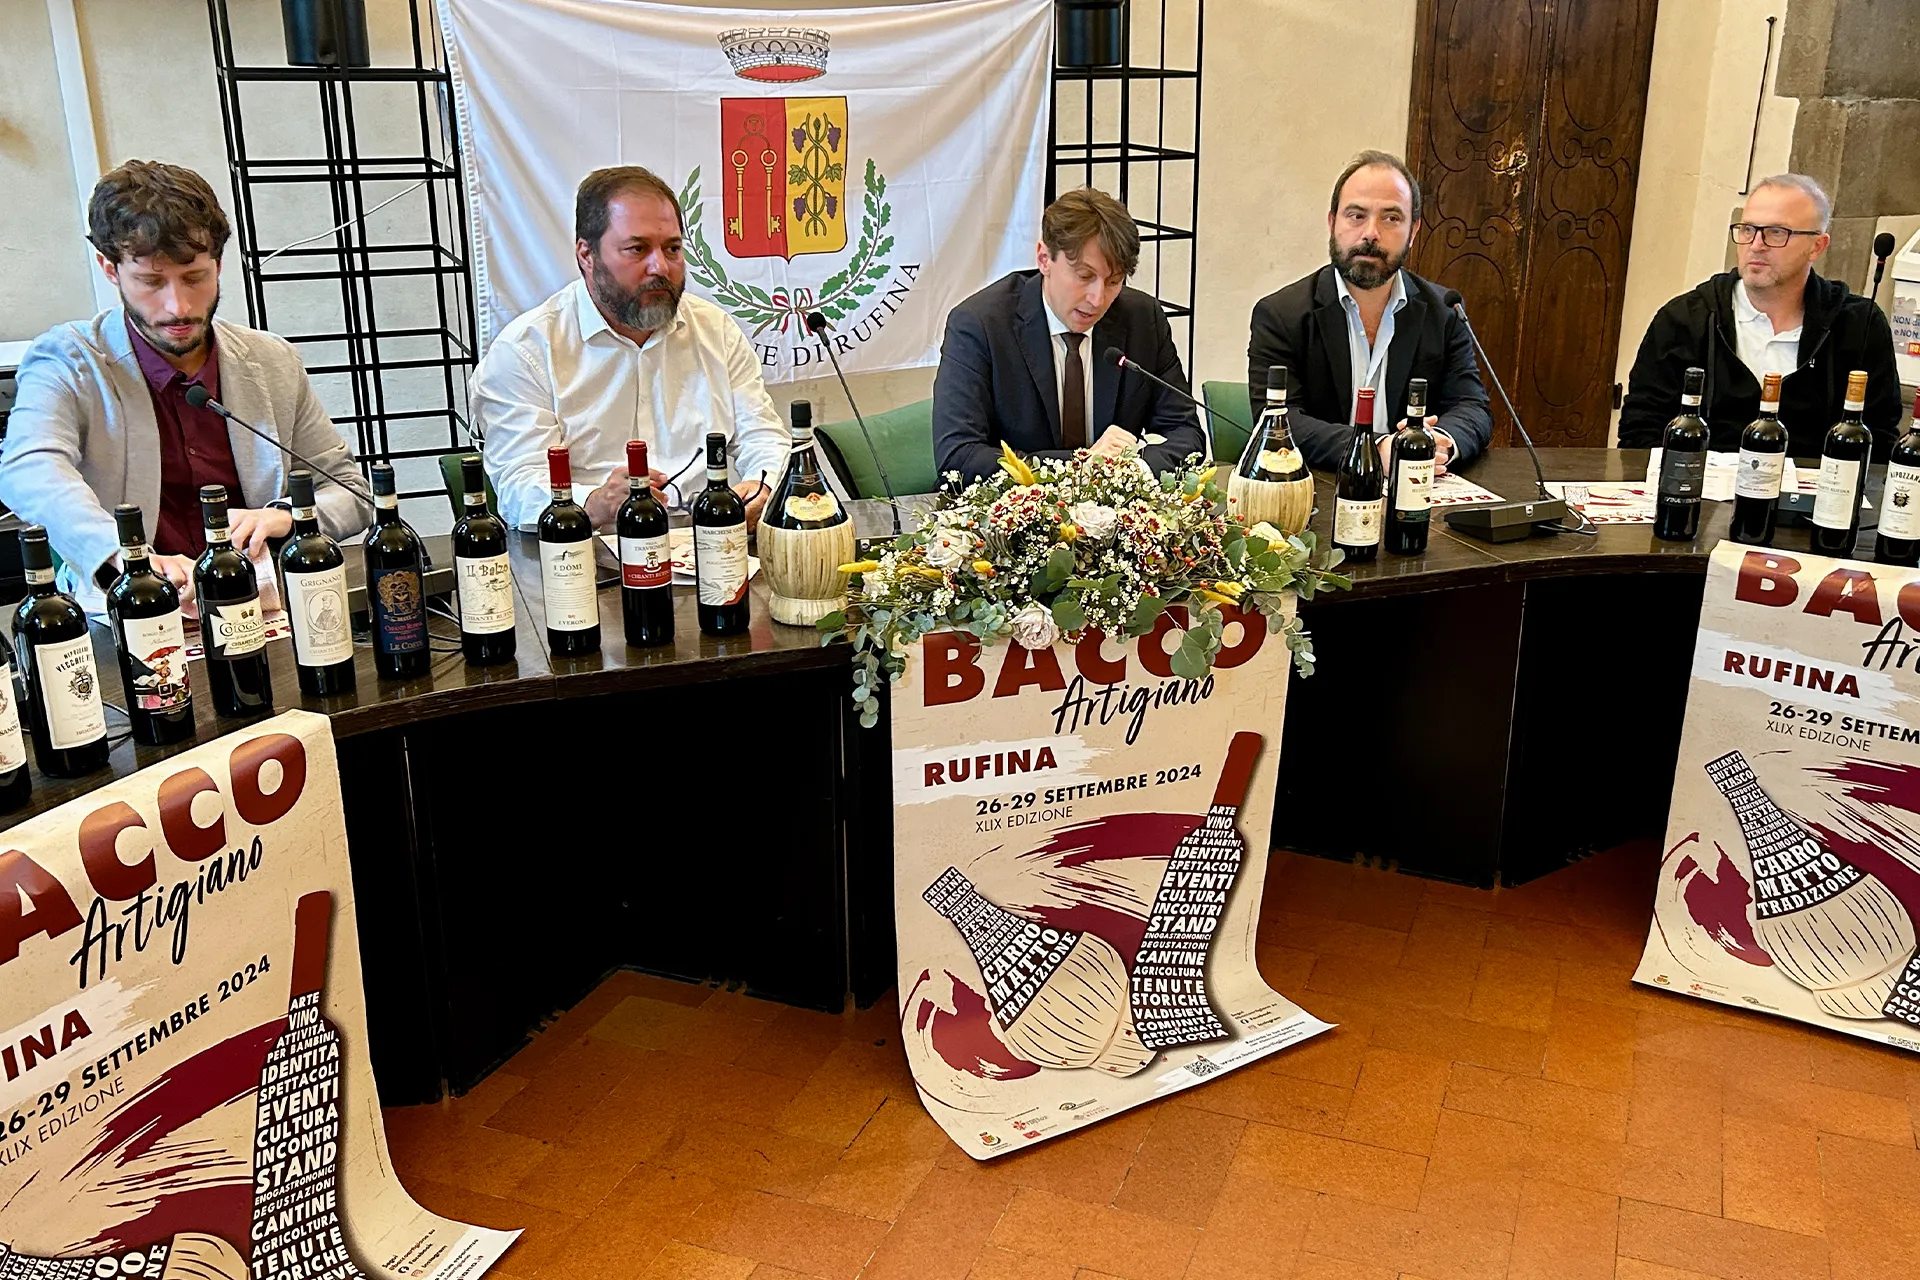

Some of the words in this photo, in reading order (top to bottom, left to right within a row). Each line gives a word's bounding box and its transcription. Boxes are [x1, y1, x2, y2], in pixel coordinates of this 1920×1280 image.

[833, 263, 920, 356] RUFINA
[1893, 316, 1910, 325] NON
[300, 574, 342, 588] GRIGNANO
[479, 562, 508, 577] Balzo
[923, 604, 1267, 707] BACCO
[1723, 651, 1860, 699] RUFINA
[1052, 674, 1214, 744] Artigiano
[1770, 702, 1833, 726] 26-29
[1766, 720, 1794, 736] XLIX
[1799, 727, 1872, 752] EDIZIONE
[924, 746, 1058, 787] RUFINA
[1706, 752, 1742, 774] CHIANTI
[1711, 760, 1748, 782] RUFINA
[976, 792, 1036, 816] 26-29
[1044, 774, 1148, 804] SETTEMBRE
[1154, 764, 1202, 786] 2024
[1717, 770, 1754, 792] FIASCO
[1728, 783, 1758, 799] PRODOTTI
[1210, 806, 1236, 816] ARTE
[1730, 789, 1764, 808] TIPICI
[1738, 801, 1777, 823] FESTA
[975, 816, 1002, 833] XLIX
[1007, 805, 1073, 828] EDIZIONE
[1192, 828, 1235, 838] ATTIVITÀ
[1206, 816, 1233, 830] VINO
[1742, 820, 1760, 831] DEL
[1762, 812, 1782, 825] VINO
[1745, 817, 1790, 838] VENDEMMIA
[0, 733, 306, 966] ACCO
[1182, 836, 1193, 844] PER
[1202, 838, 1241, 848] BAMBINI
[1748, 823, 1799, 850] MEMORIA
[1751, 832, 1806, 858] PATRIMONIO
[1168, 860, 1239, 873] SPETTACOLI
[1174, 846, 1244, 860] IDENTITÀ
[1753, 839, 1820, 878] CARRO
[924, 868, 958, 900] CHIANTI
[1162, 872, 1235, 890] EVENTI
[1756, 852, 1840, 898] MATTO
[930, 874, 964, 907] RUFINA
[936, 881, 972, 914] FIASCO
[1158, 889, 1226, 904] CULTURA
[1757, 865, 1860, 916] TRADIZIONE
[70, 836, 263, 989] Artigiano
[952, 896, 984, 924] TIPICI
[962, 904, 998, 937] FESTA
[1147, 916, 1218, 932] STAND
[1153, 902, 1222, 917] INCONTRI
[967, 930, 984, 944] DEL
[983, 910, 1003, 929] VINO
[970, 913, 1010, 950] VENDEMMIA
[974, 916, 1020, 960] MEMORIA
[980, 920, 1026, 967] PATRIMONIO
[982, 924, 1040, 984] CARRO
[1136, 951, 1206, 966] CANTINE
[1140, 941, 1209, 950] DEGUSTAZIONI
[989, 930, 1059, 1005] MATTO
[996, 932, 1077, 1024] TRADIZIONE
[1133, 966, 1204, 978] AGRICOLTURA
[1132, 978, 1205, 994] TENUTE
[1132, 993, 1208, 1006] STORICHE
[290, 992, 320, 1011] ARTE
[1133, 1006, 1212, 1020] VALDISIEVE
[82, 994, 210, 1088] SETTEMBRE
[218, 955, 271, 1003] 2024
[289, 1006, 318, 1030] VINO
[1136, 1014, 1219, 1032] COMUNITÀ
[1142, 1022, 1223, 1040] ARTIGIANATO
[2, 1010, 92, 1082] INA
[267, 1048, 286, 1064] PER
[290, 1030, 334, 1054] BAMBINI
[276, 1020, 326, 1048] ATTIVITÀ
[1144, 1030, 1229, 1049] ECOLOGIA
[262, 1038, 340, 1086] IDENTITÀ
[260, 1060, 339, 1103] SPETTACOLI
[38, 1077, 124, 1143] EDIZIONE
[258, 1077, 339, 1129] EVENTI
[256, 1103, 338, 1148] CULTURA
[255, 1121, 338, 1168] INCONTRI
[256, 1141, 337, 1194] STAND
[253, 1176, 335, 1220] DEGUSTAZIONI
[254, 1164, 336, 1206] ENOGASTRONOMICI
[252, 1190, 336, 1241] CANTINE
[252, 1212, 338, 1258] AGRICOLTURA
[252, 1226, 342, 1280] TENUTE
